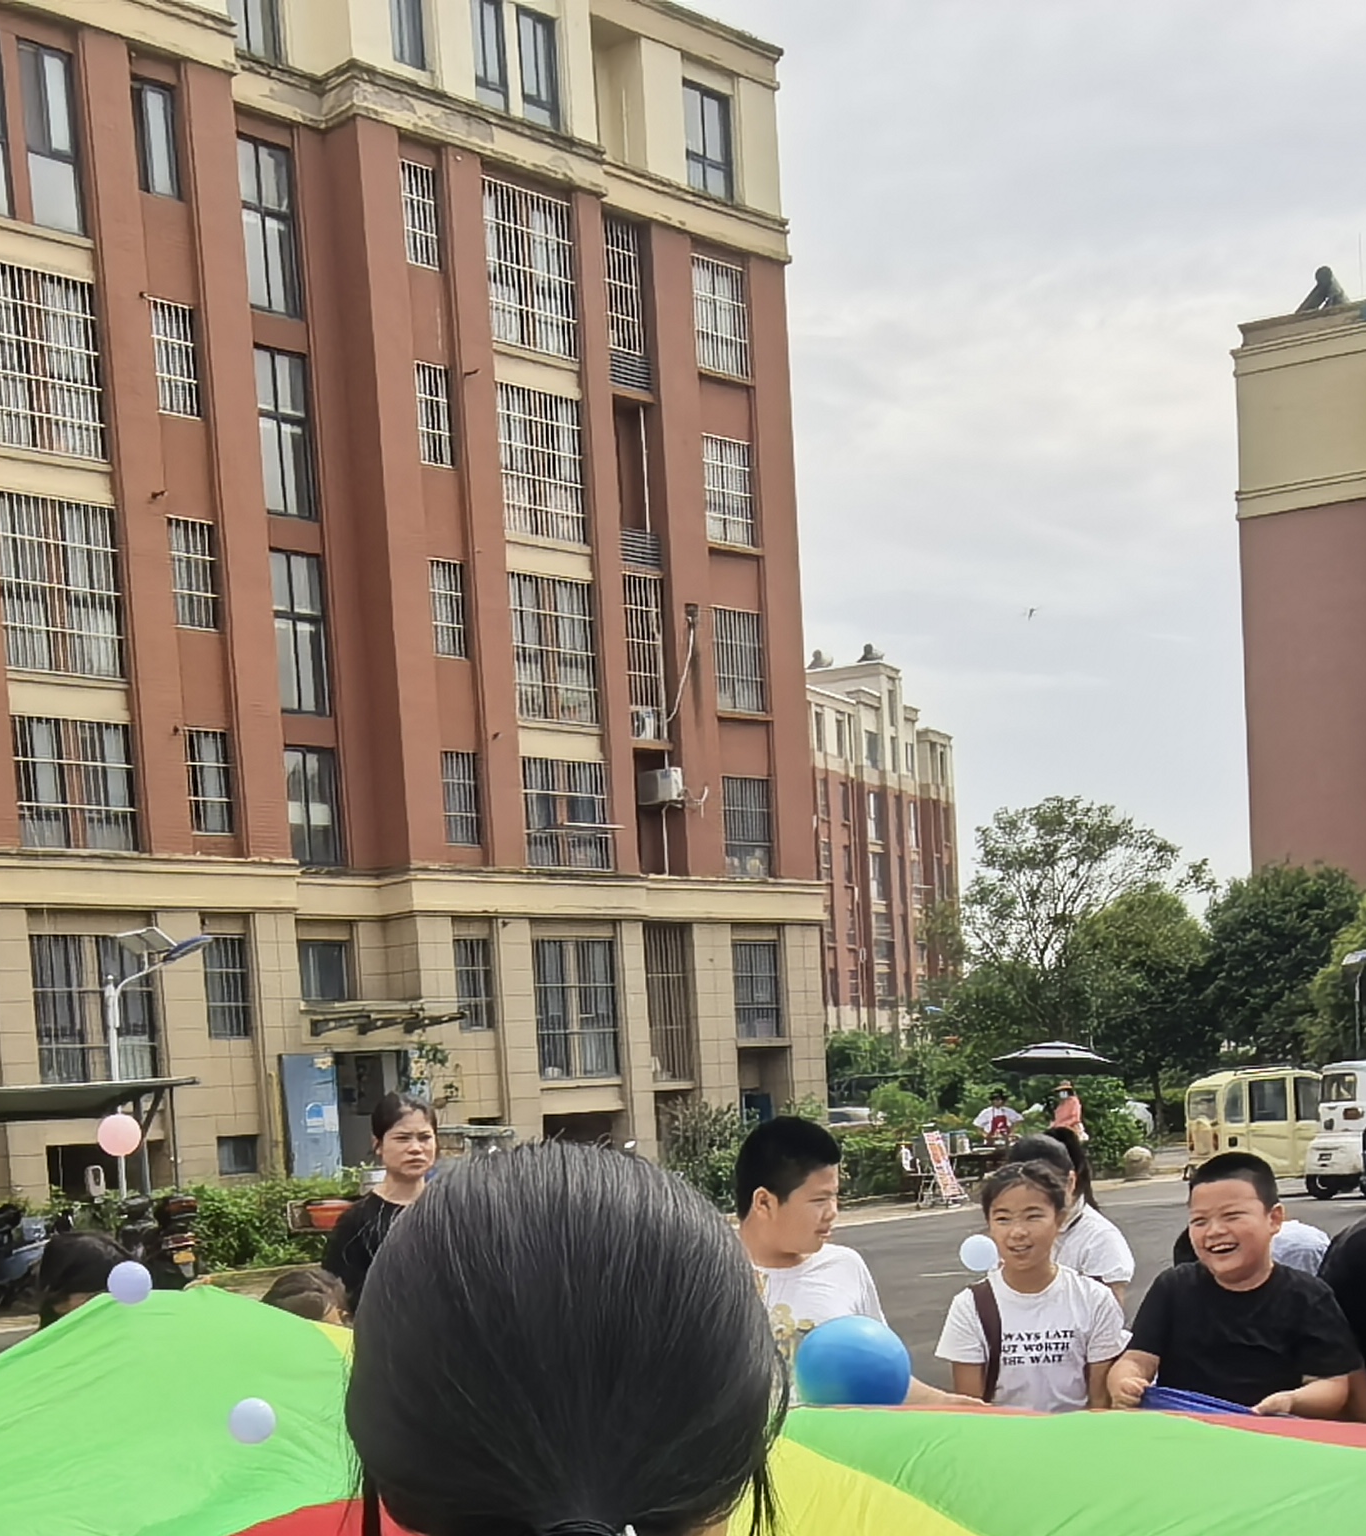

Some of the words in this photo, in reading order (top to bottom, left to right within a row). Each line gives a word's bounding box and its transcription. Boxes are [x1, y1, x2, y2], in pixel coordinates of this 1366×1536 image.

[1003, 1332, 1042, 1341] WAYS
[1023, 1342, 1070, 1352] WORTH
[1029, 1354, 1064, 1364] WAIT
